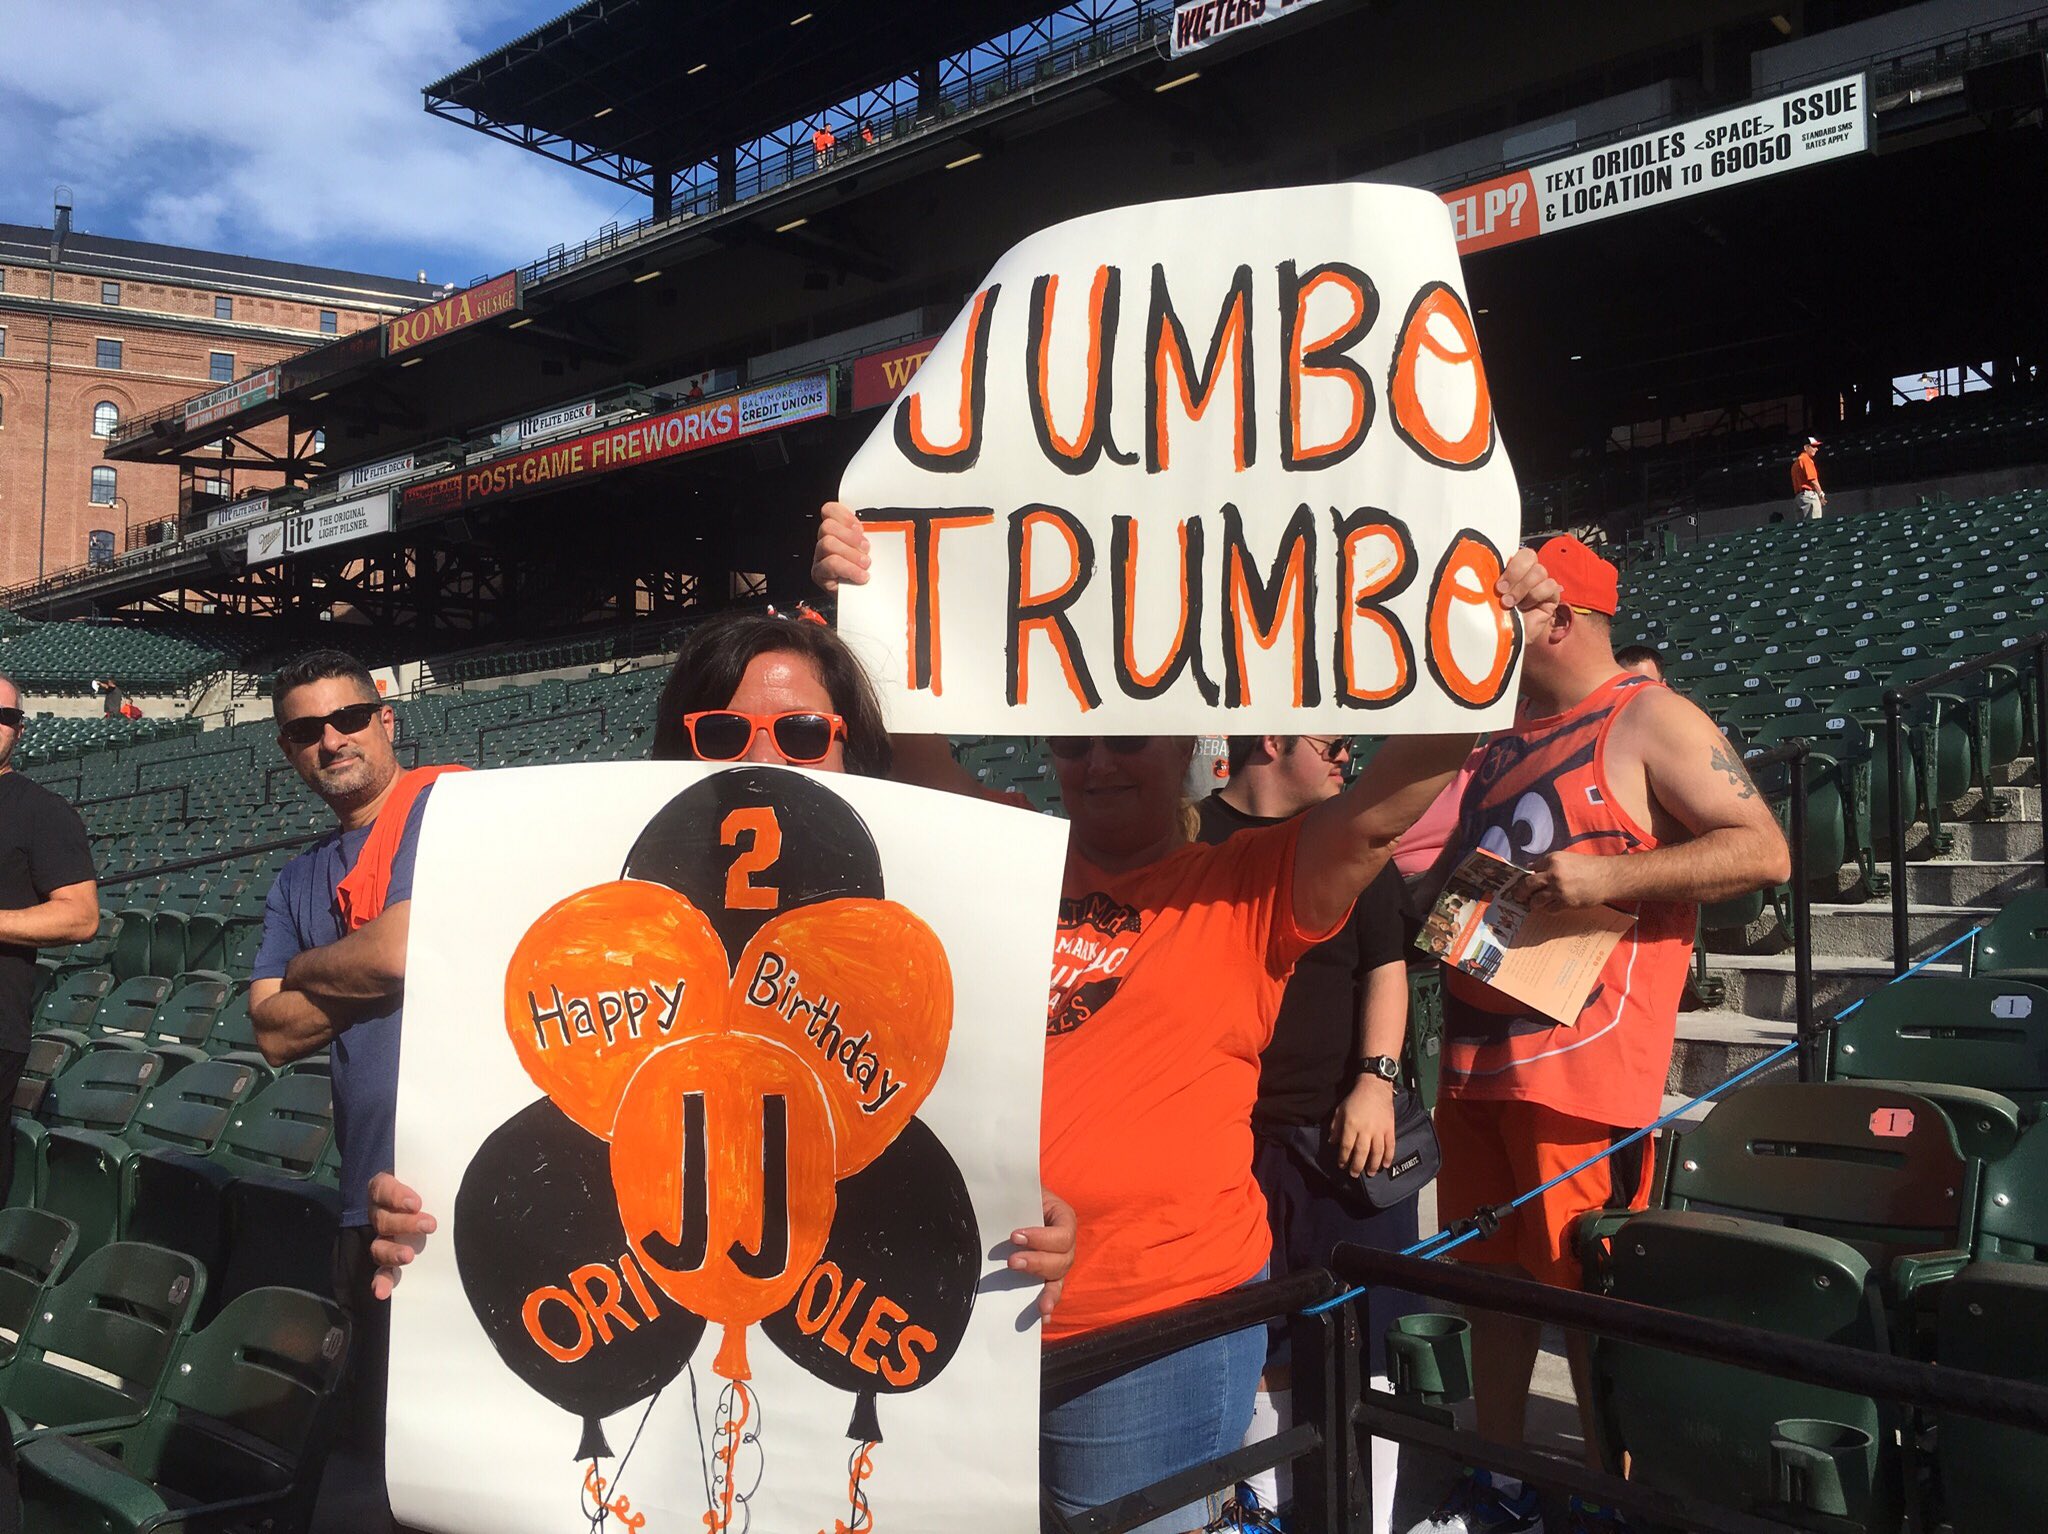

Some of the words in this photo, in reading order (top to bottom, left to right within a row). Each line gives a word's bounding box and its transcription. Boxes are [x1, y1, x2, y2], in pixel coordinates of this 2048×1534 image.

[1177, 0, 1266, 49] WIETERS
[1545, 164, 1585, 193] TEXT
[1592, 132, 1686, 181] ORIOLES
[1782, 83, 1857, 128] ISSUE
[1801, 126, 1836, 142] STANDARD
[1836, 121, 1853, 134] SMS
[1805, 138, 1827, 151] RATES
[1828, 131, 1850, 146] APPLY
[1546, 204, 1557, 222] &
[1562, 165, 1672, 218] LOCATION
[1682, 164, 1703, 184] TO
[1711, 133, 1791, 178] 69050
[391, 294, 474, 351] ROMA
[476, 289, 515, 319] SAUSAGE
[893, 259, 1496, 475] JUMBO
[742, 388, 793, 410] BALTIMORE
[798, 382, 823, 396] AREA
[742, 404, 779, 421] CREDIT
[782, 392, 823, 411] UNIONS
[540, 413, 562, 429] FLITE
[564, 406, 585, 422] DECK
[370, 466, 388, 479] FLITE
[389, 460, 406, 474] DECK
[467, 445, 584, 499] POST-GAME
[592, 404, 733, 468] FIREWORKS
[232, 506, 247, 518] FLITE
[248, 503, 262, 513] DECK
[319, 515, 333, 527] THE
[334, 506, 366, 523] ORIGINAL
[318, 527, 338, 540] LIGHT
[855, 502, 1525, 713] TRUMBO
[1193, 739, 1228, 756] SEBA
[720, 806, 783, 911] 2
[528, 978, 687, 1050] Happy
[746, 952, 904, 1116] Birthday
[522, 1252, 662, 1364] ORI
[797, 1261, 938, 1386] OLES
